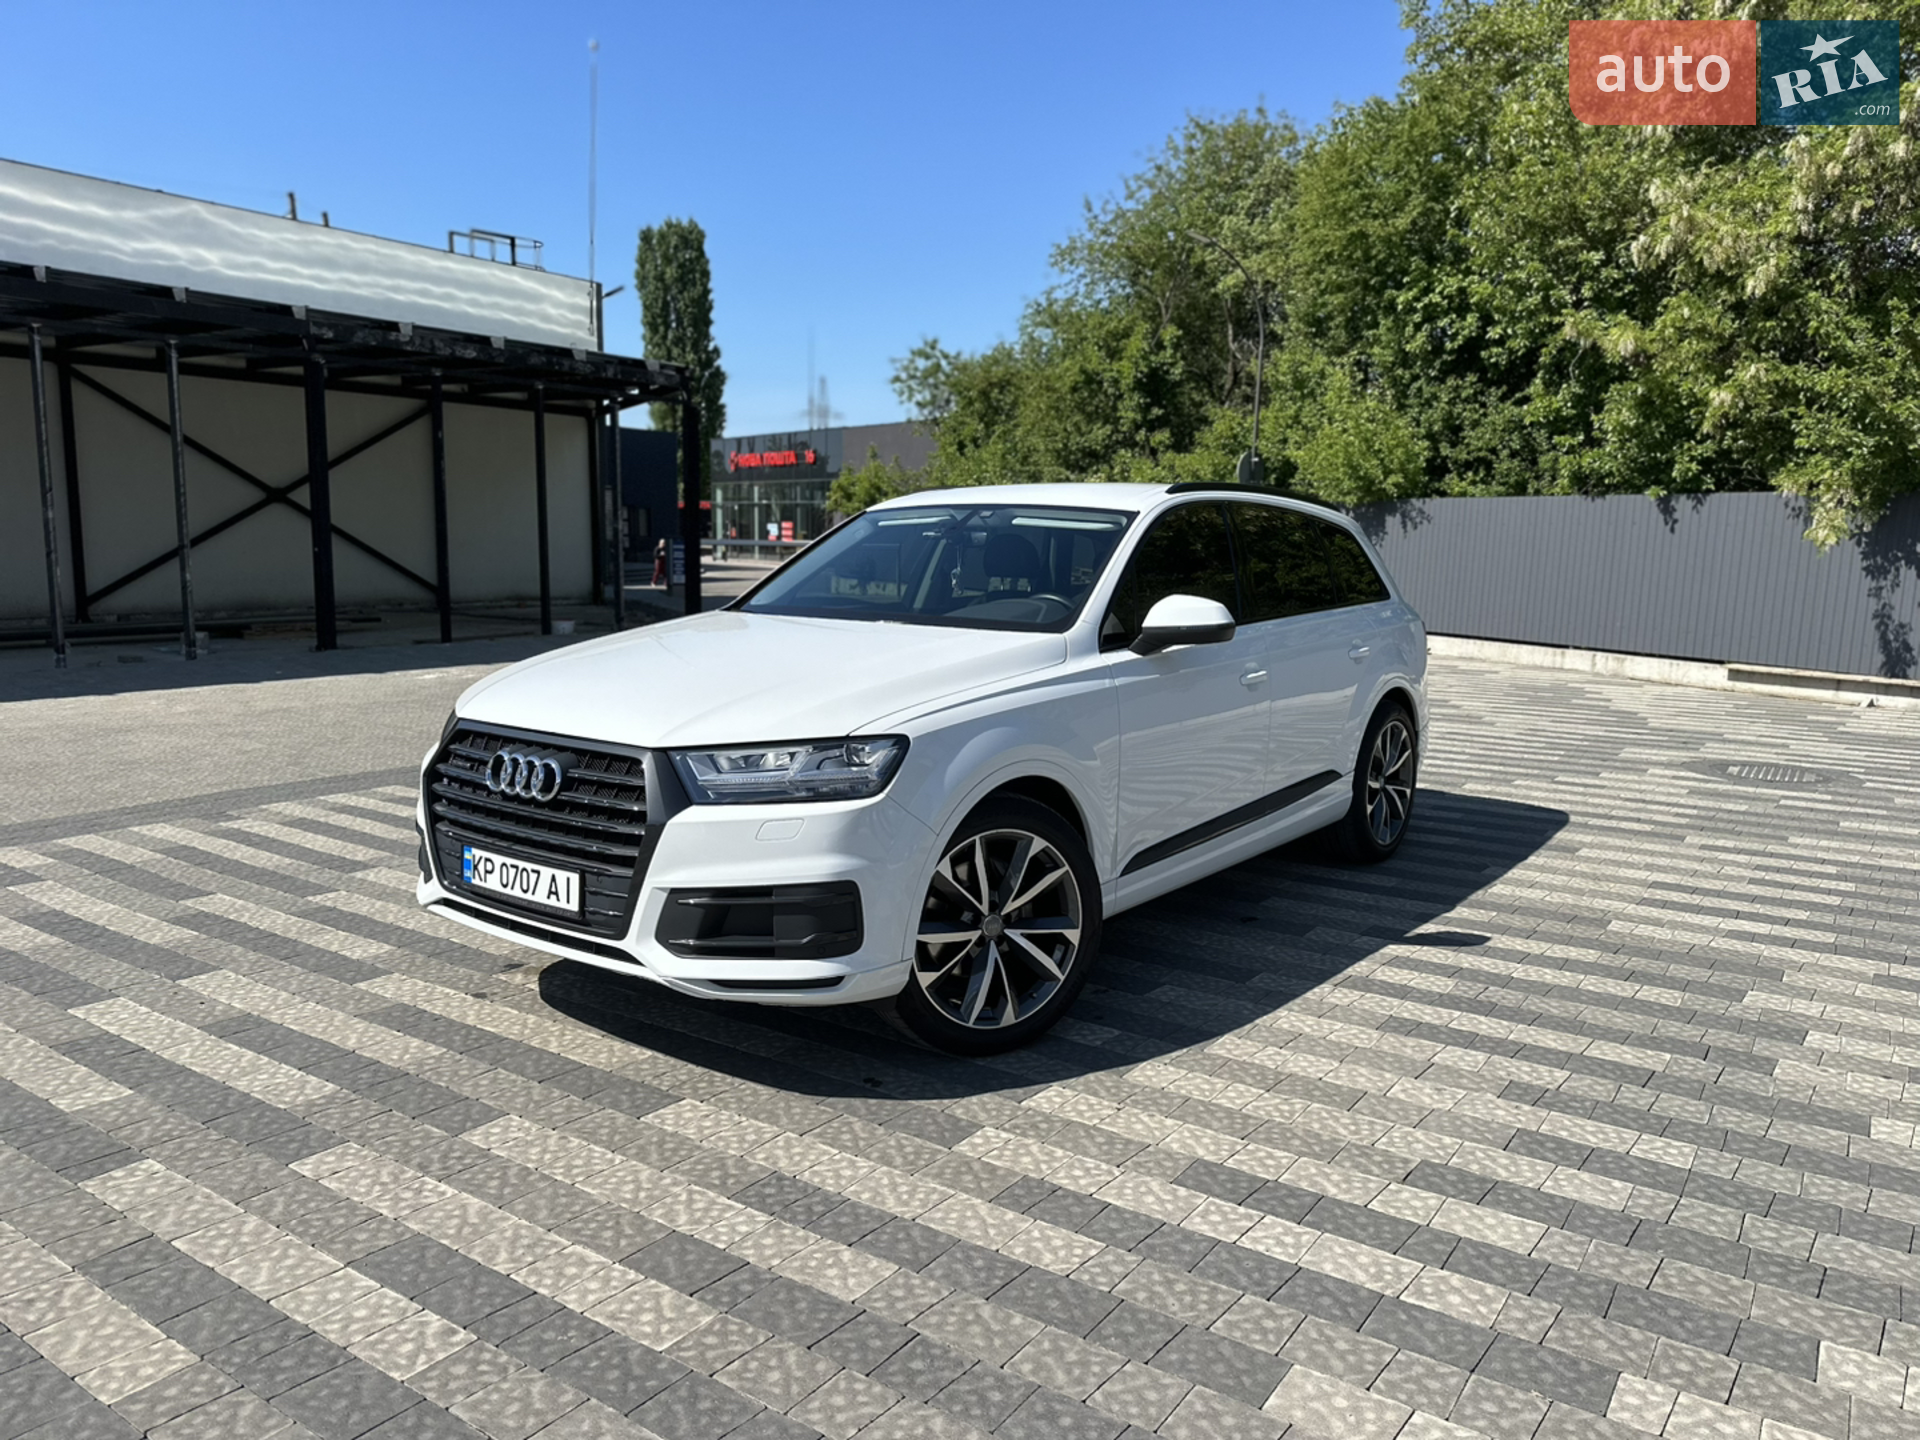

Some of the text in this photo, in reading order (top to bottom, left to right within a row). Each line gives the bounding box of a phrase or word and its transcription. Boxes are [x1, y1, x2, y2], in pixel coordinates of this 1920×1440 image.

[763, 450, 796, 465] ПОШТА
[472, 853, 495, 883] KP
[499, 861, 541, 896] 0707
[546, 873, 571, 905] AI
